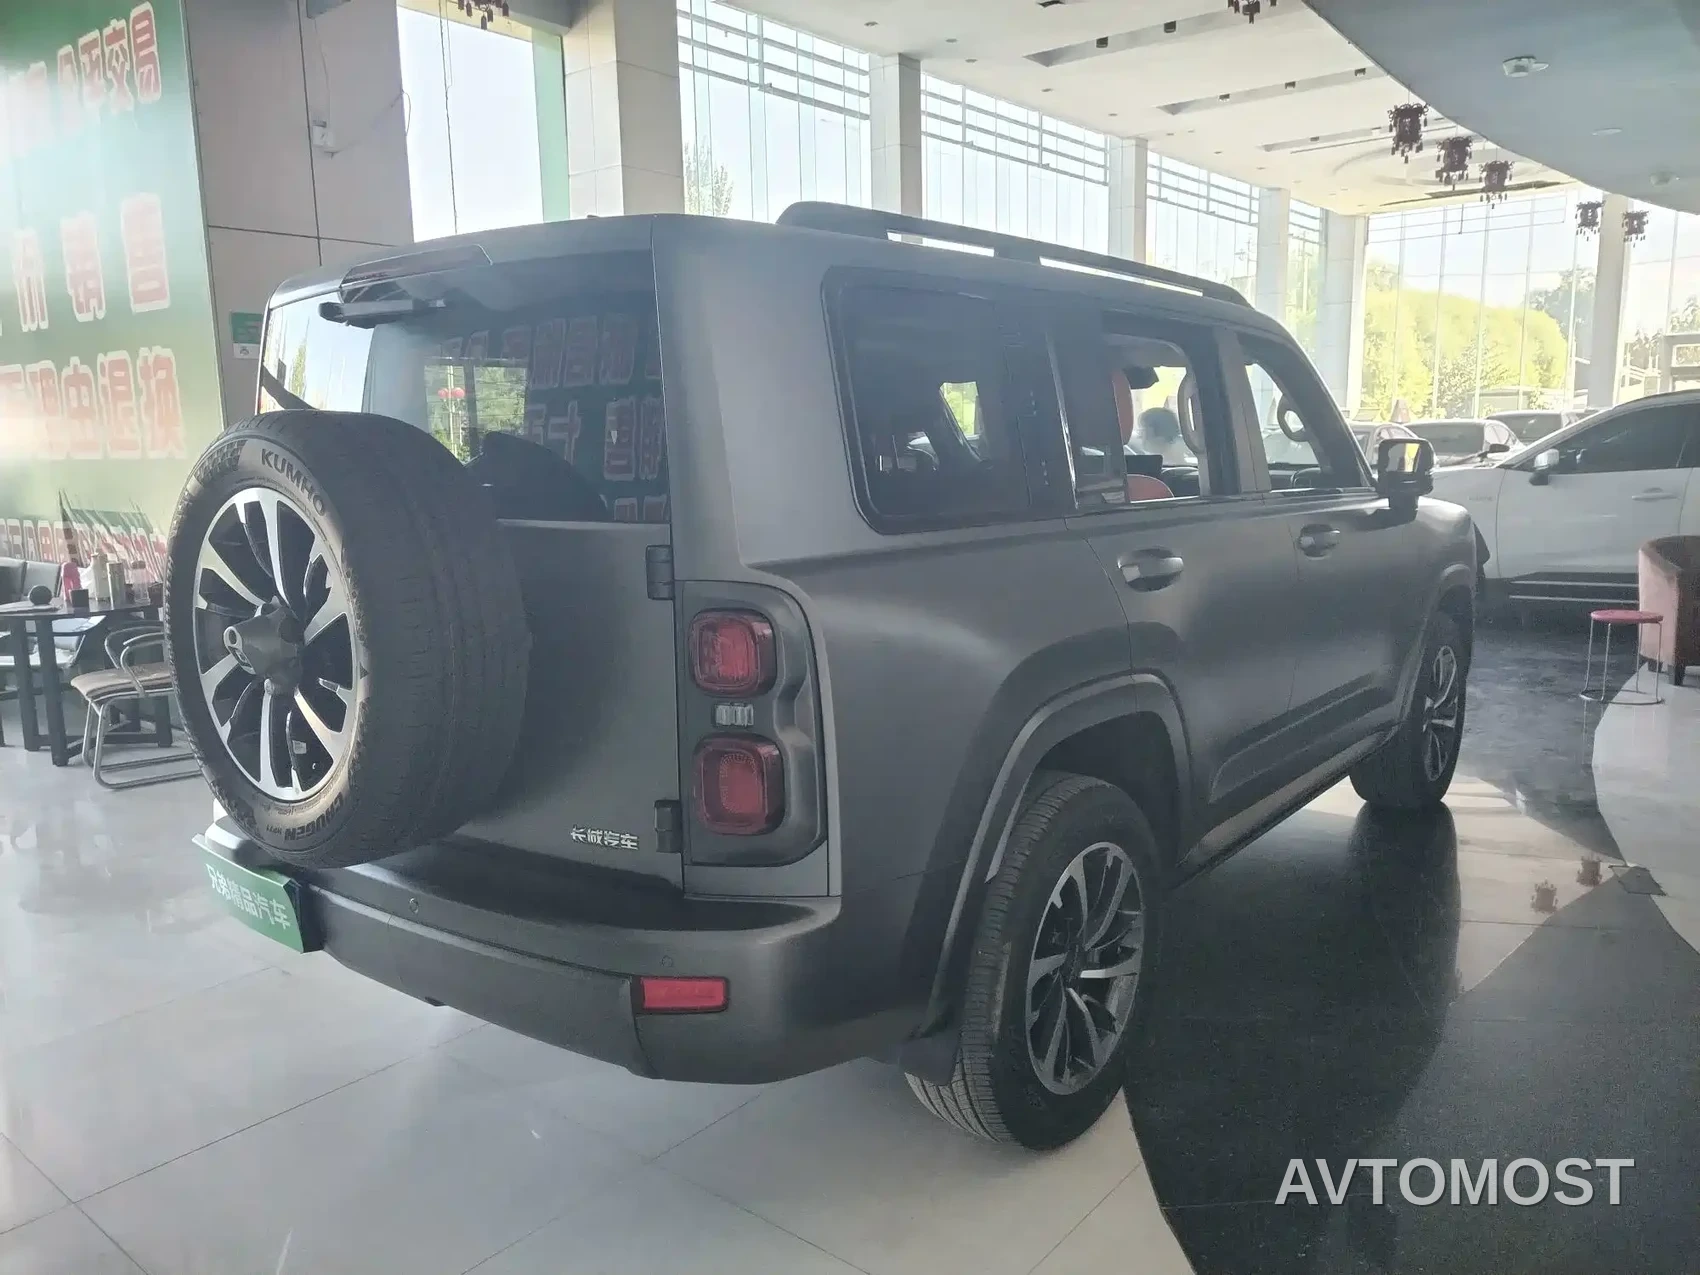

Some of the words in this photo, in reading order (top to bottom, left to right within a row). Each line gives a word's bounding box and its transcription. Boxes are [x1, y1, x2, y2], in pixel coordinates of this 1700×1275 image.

[261, 448, 326, 516] KUMHO
[570, 823, 639, 850] 长城汽车
